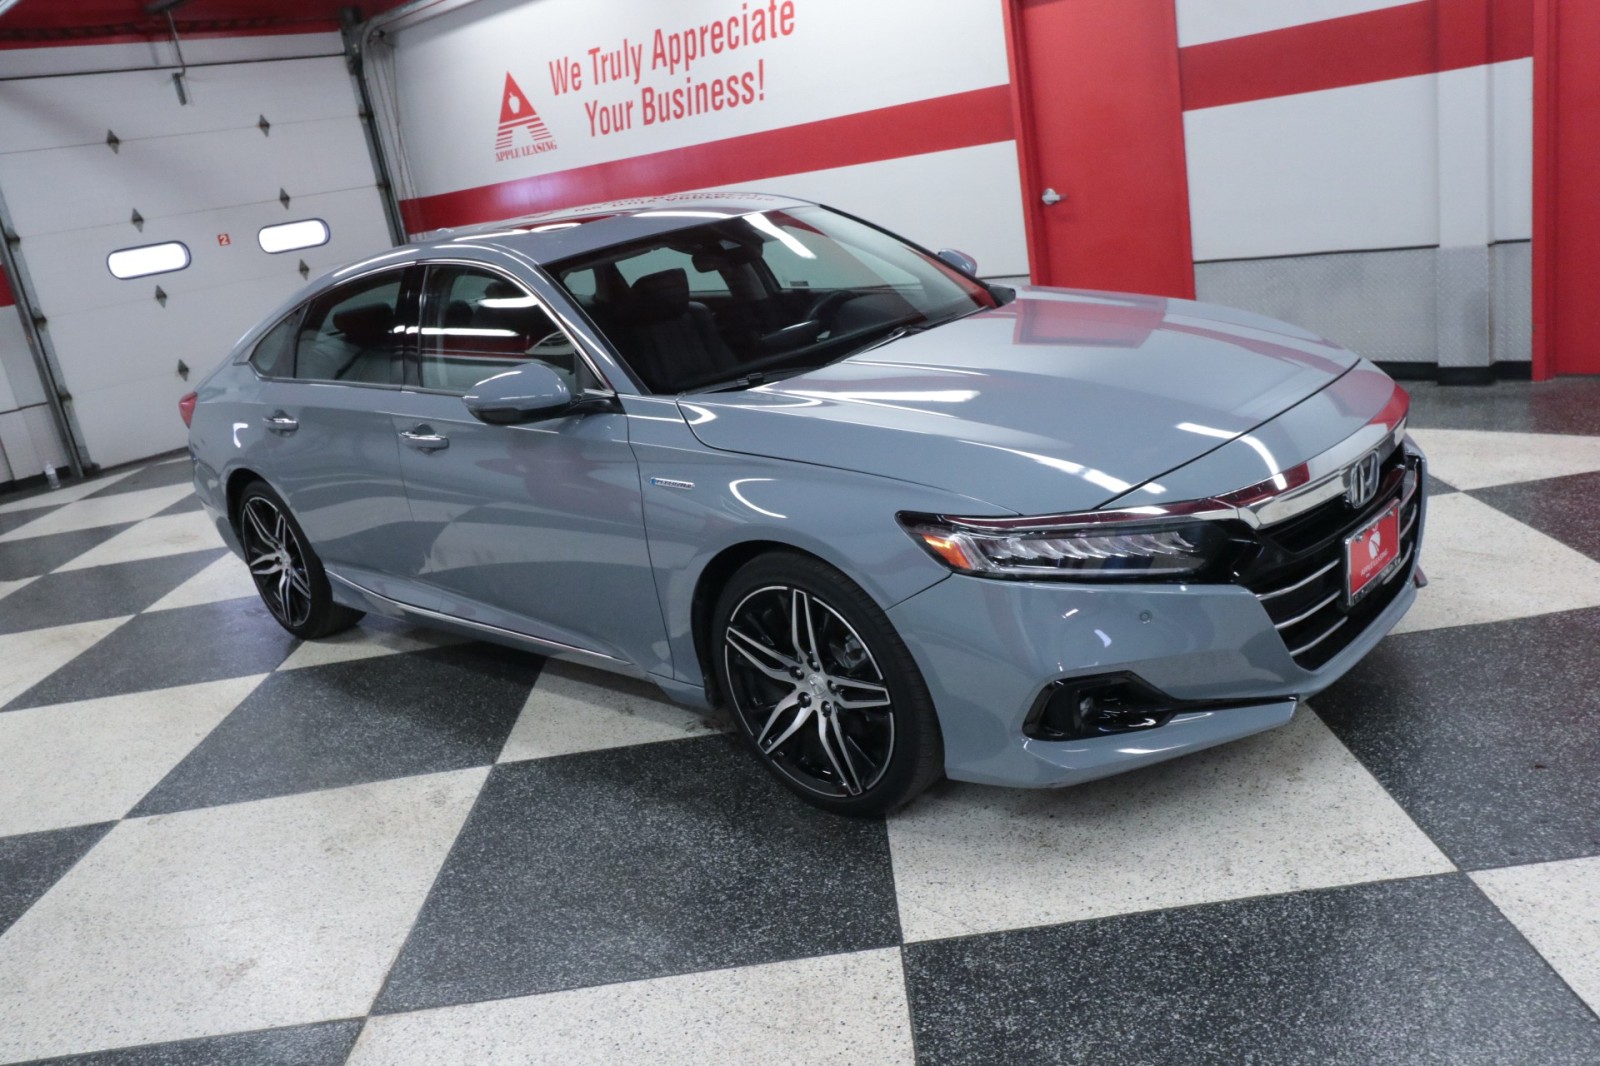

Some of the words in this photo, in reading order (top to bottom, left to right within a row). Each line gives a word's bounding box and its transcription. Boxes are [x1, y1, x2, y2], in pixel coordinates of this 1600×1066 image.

[548, 56, 582, 96] We
[588, 38, 643, 84] Truly
[652, 0, 796, 75] Appreciate
[584, 99, 634, 137] Your
[641, 59, 765, 126] Business!
[495, 147, 520, 162] APPLE
[521, 140, 557, 158] LEASING
[219, 234, 229, 245] 2
